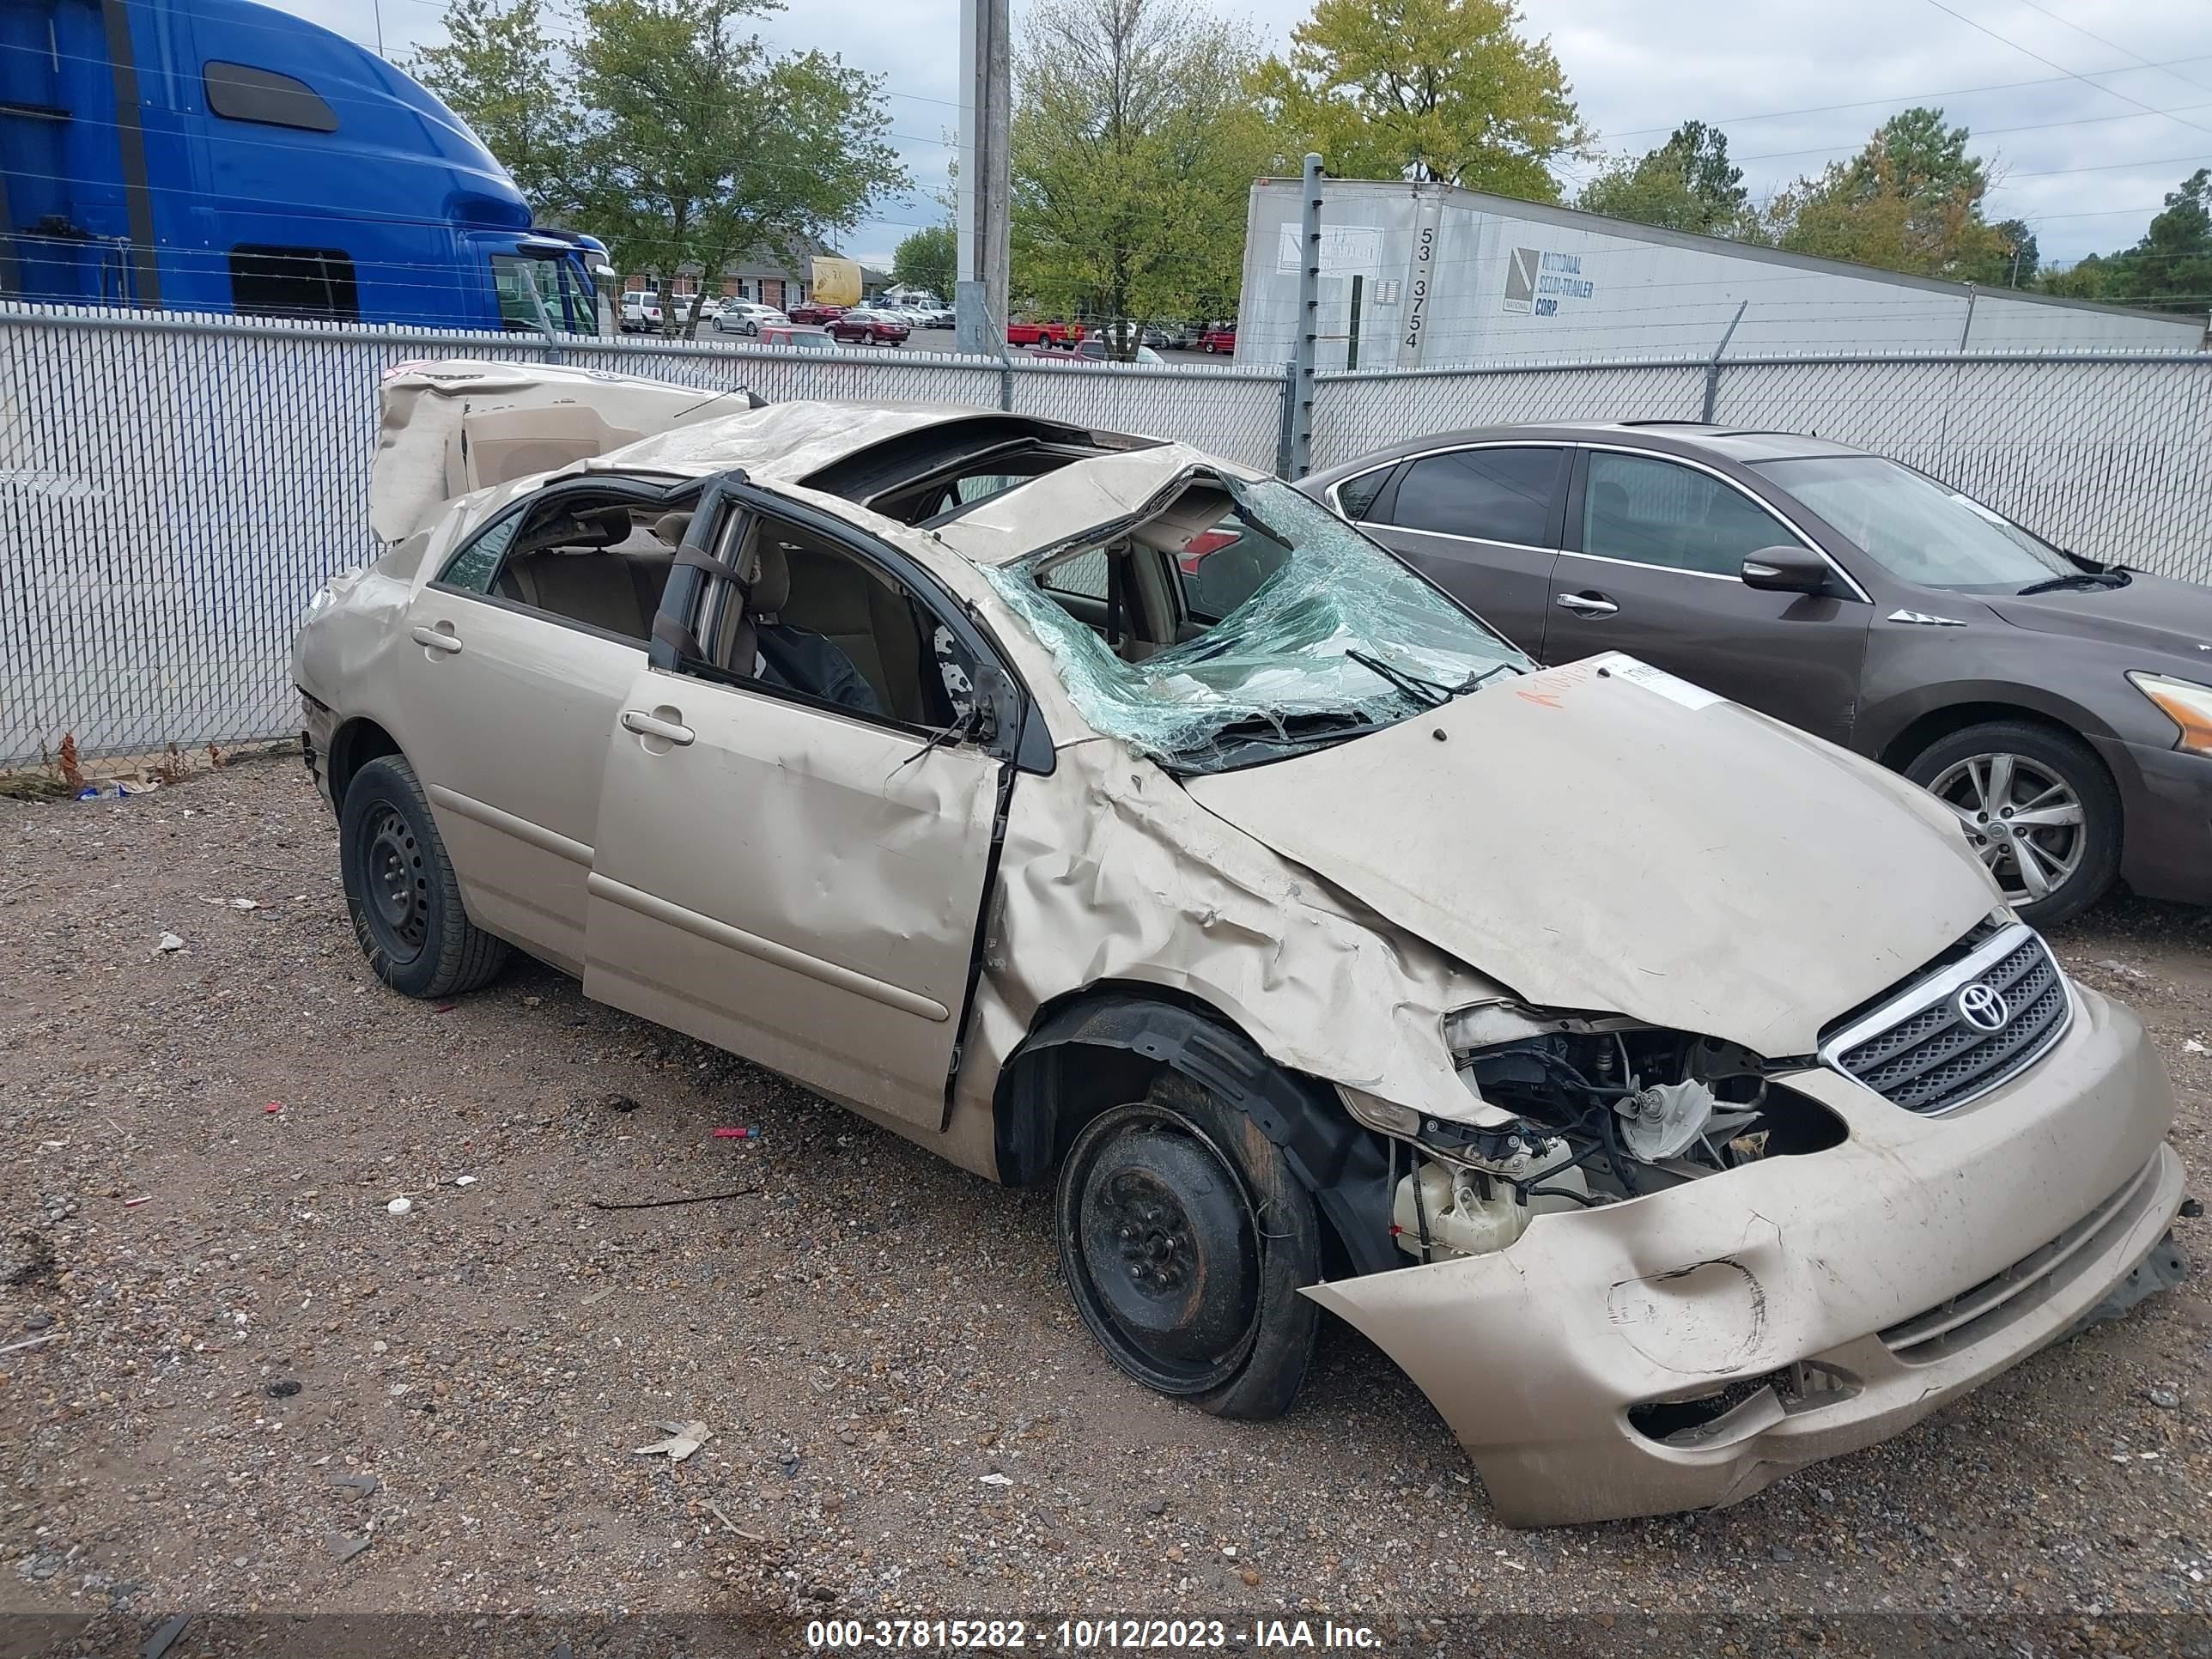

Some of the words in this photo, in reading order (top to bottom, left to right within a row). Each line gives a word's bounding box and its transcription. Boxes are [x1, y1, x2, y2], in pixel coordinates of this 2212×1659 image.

[1542, 252, 1581, 275] NATIONAL
[1406, 228, 1432, 348] 53-3754
[1539, 275, 1594, 299] SEMI-TRAILER
[1535, 298, 1558, 318] CORP.
